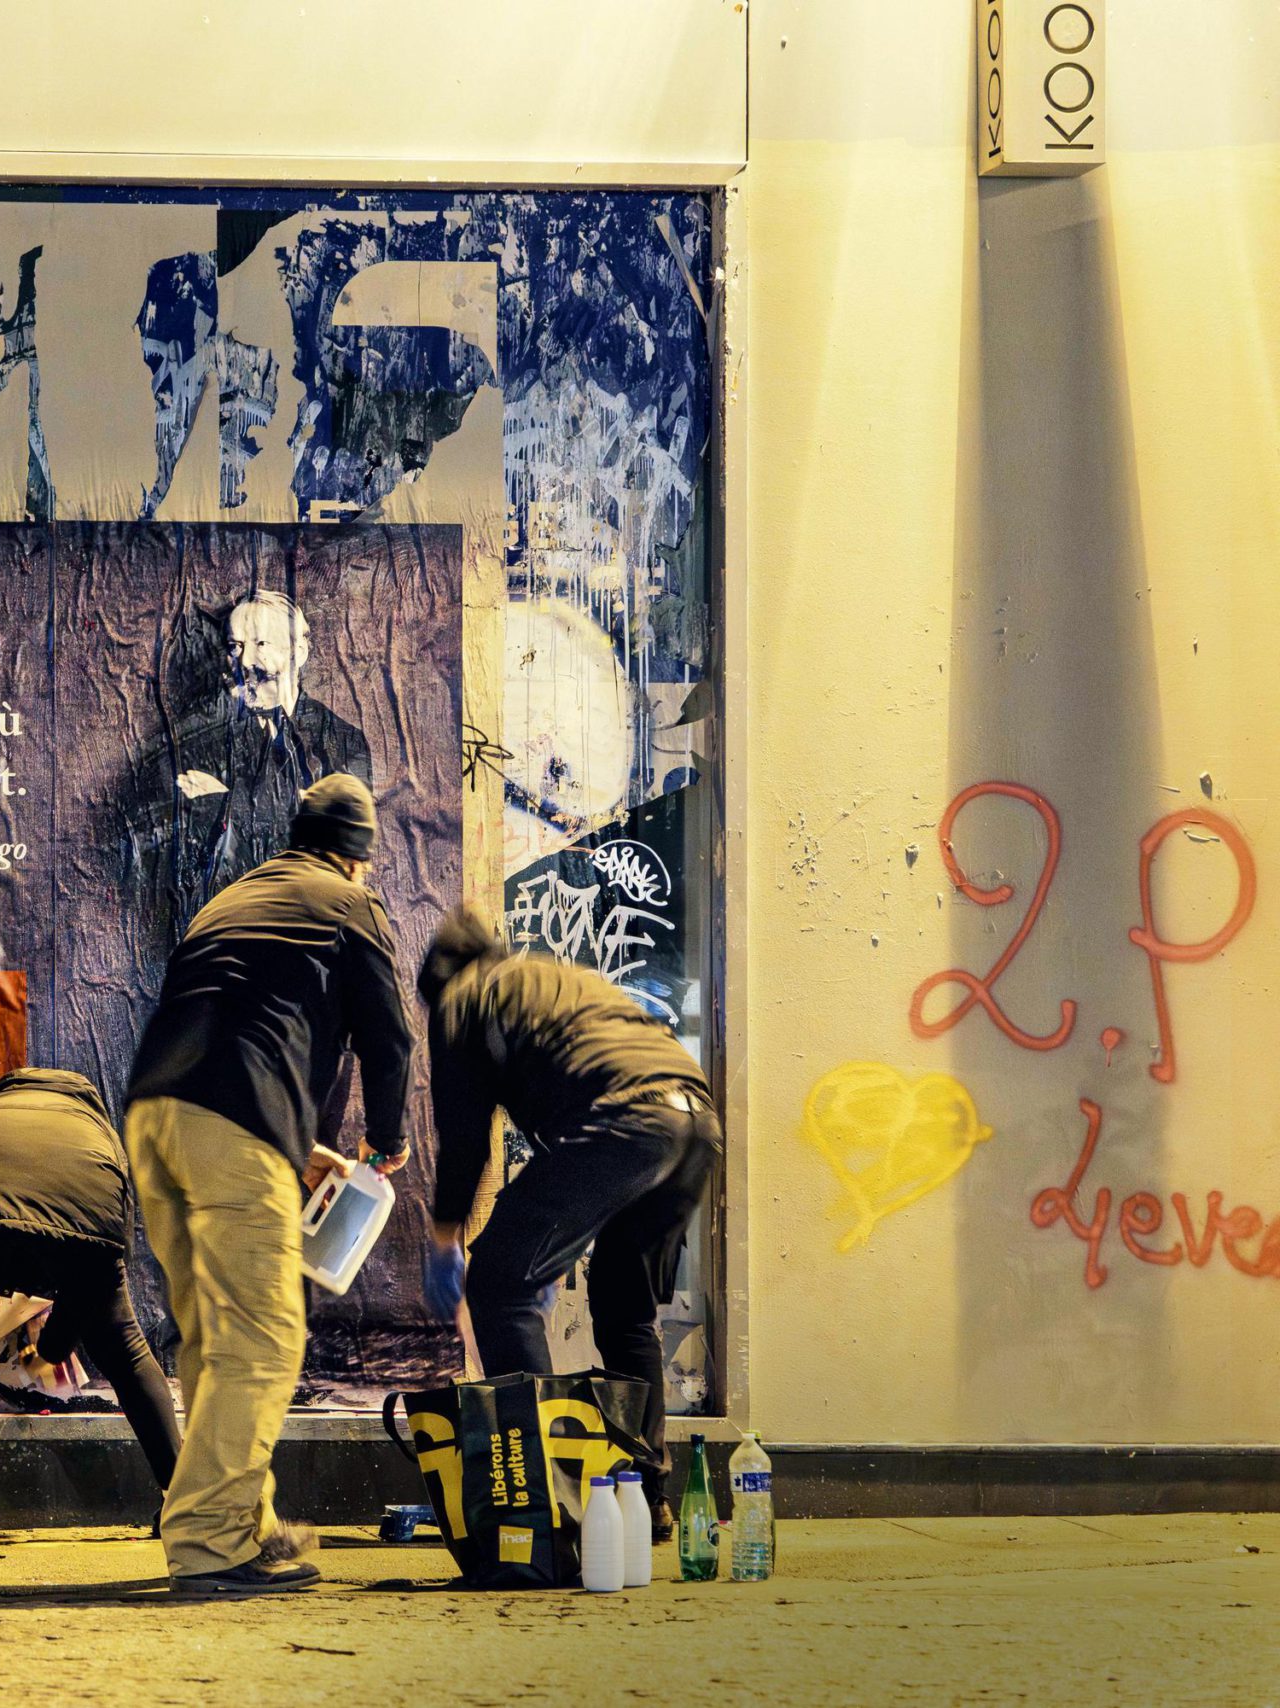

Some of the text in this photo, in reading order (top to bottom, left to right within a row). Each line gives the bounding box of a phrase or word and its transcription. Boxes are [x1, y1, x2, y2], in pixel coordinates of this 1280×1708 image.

[987, 0, 1001, 158] KOO
[489, 1433, 509, 1507] Libérons
[507, 1427, 530, 1508] la culture
